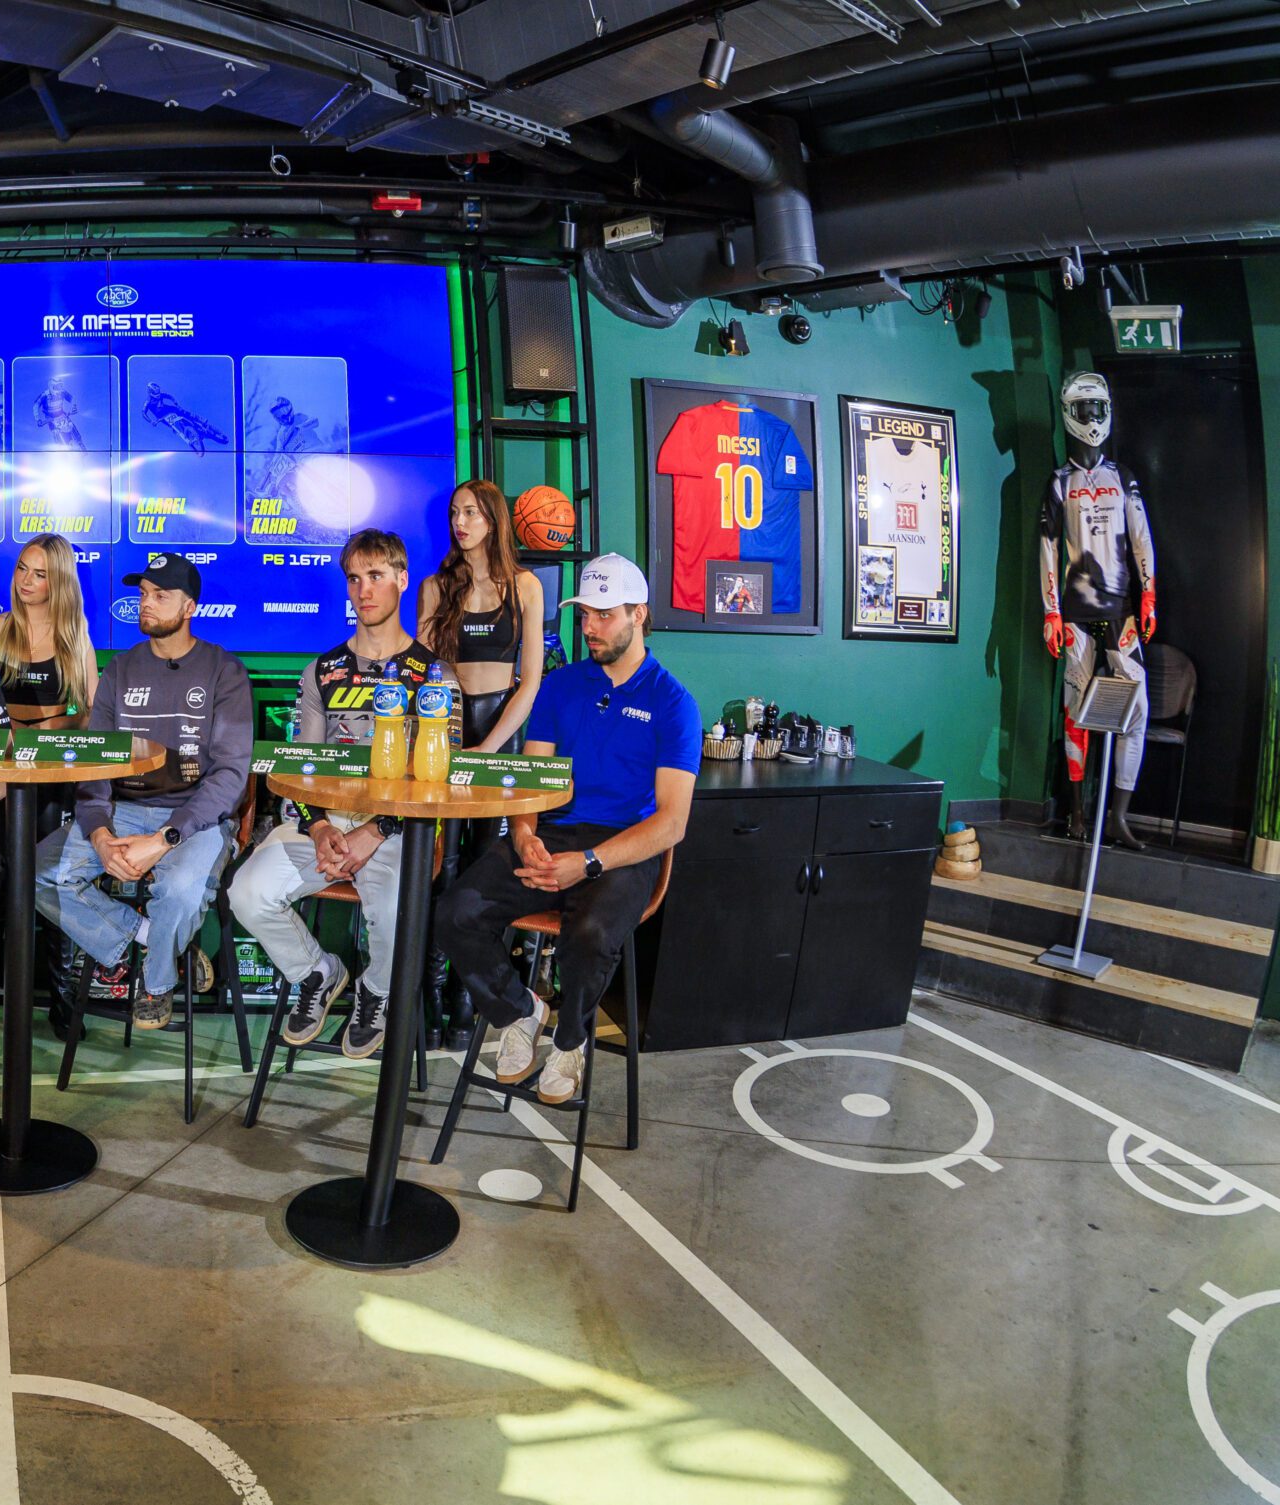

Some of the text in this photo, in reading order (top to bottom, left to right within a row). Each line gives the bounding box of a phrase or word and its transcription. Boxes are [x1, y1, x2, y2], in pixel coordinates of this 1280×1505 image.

[43, 314, 194, 331] MX MASTERS
[878, 417, 925, 437] LEGEND
[717, 434, 761, 456] MESSI
[715, 462, 763, 530] 10
[857, 474, 868, 520] SPURS
[136, 498, 187, 514] KAAREL
[251, 499, 283, 515] ERKI
[19, 516, 95, 533] KRESTINOV
[137, 516, 167, 533] TILK
[251, 518, 298, 535] KAHRO
[888, 533, 926, 545] MANSION
[263, 554, 332, 566] P6 167P
[192, 604, 237, 618] HOR
[263, 602, 320, 613] YAMAHAKESKUS
[463, 624, 496, 632] UNIBET
[407, 659, 426, 671] ADAC
[628, 707, 651, 720] YAMAHA
[37, 735, 106, 744] ERKI KAHRO
[274, 747, 350, 757] KAAREL TILK
[339, 764, 369, 772] UNIBET
[531, 761, 570, 769] TALVIKU
[540, 777, 570, 785] UNIBET
[238, 968, 255, 976] SUUR
